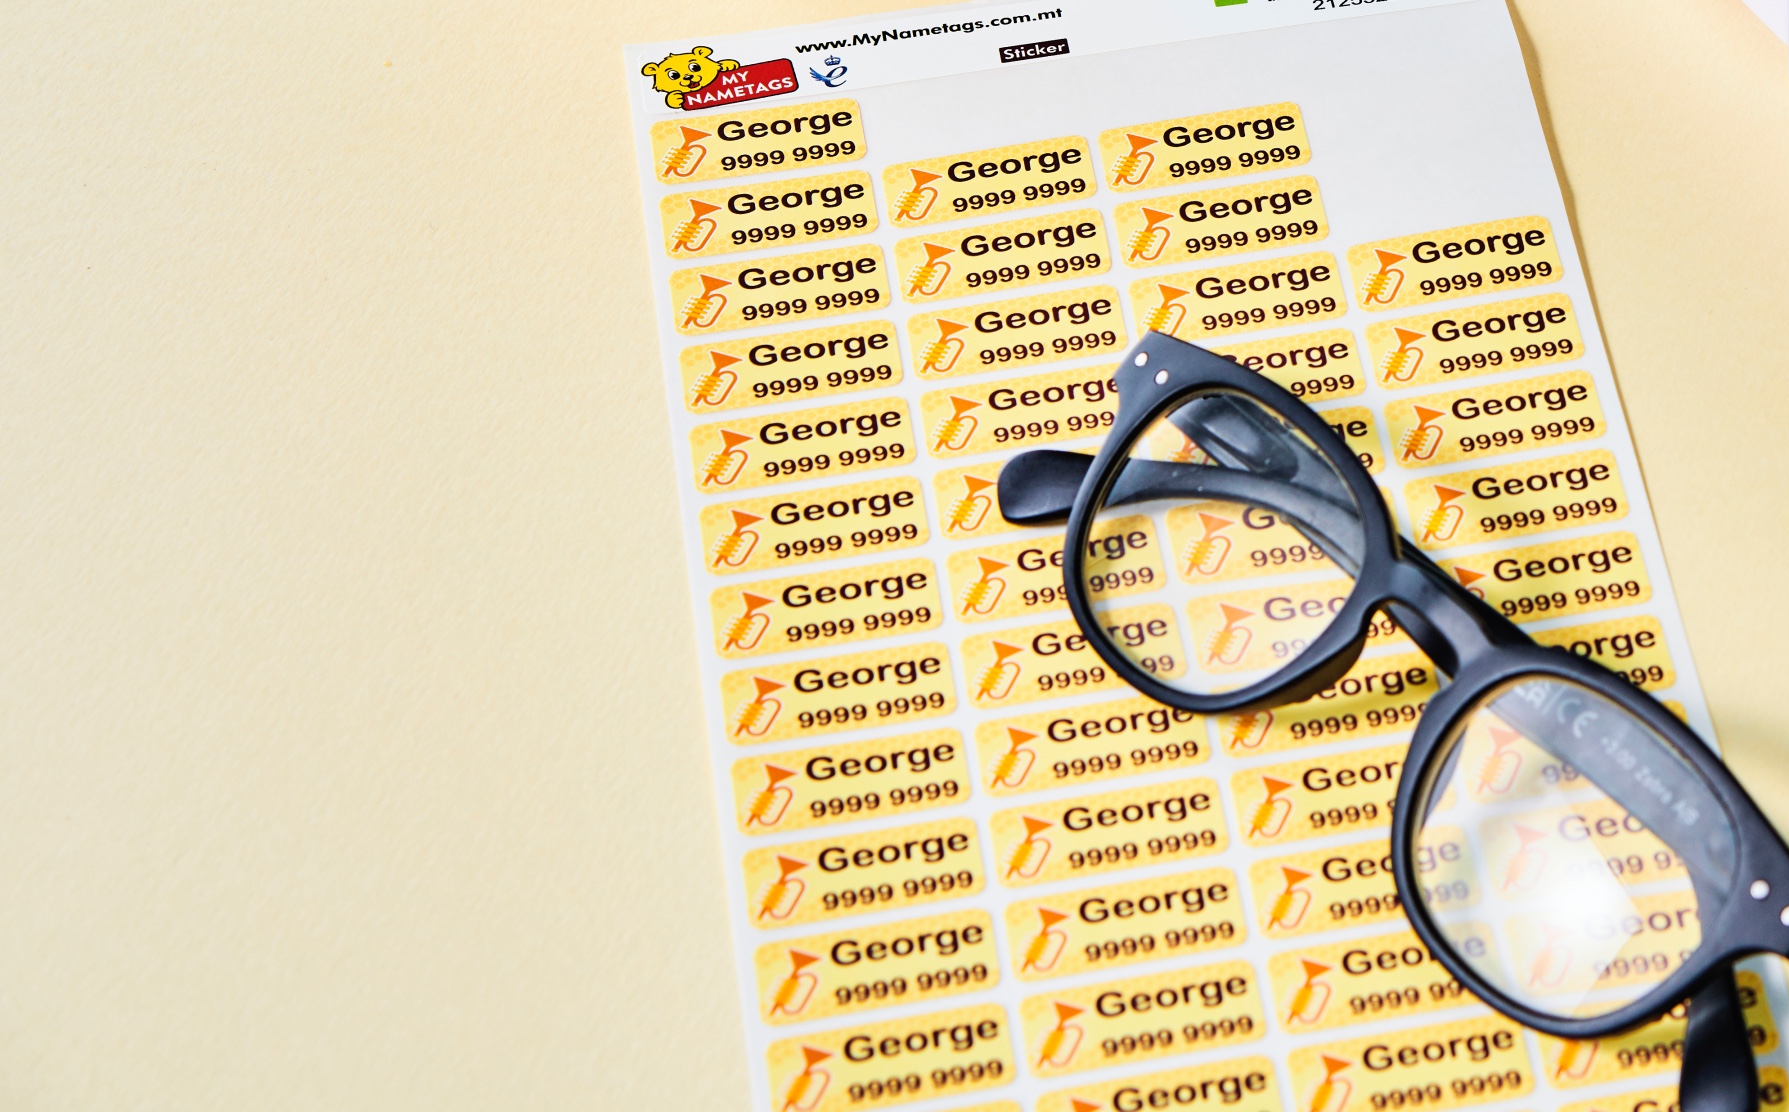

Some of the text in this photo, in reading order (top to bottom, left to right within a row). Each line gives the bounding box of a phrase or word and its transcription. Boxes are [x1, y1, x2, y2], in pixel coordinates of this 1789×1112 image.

[795, 8, 1063, 53] www.MyNametags.com.mt
[1002, 41, 1066, 60] Sticker
[687, 77, 794, 106] NAMETAGS
[722, 71, 749, 86] MY
[717, 112, 852, 141] George
[1163, 116, 1295, 147] George
[721, 141, 855, 171] 9999 9999
[948, 149, 1081, 182] George
[1169, 145, 1300, 178] 9999 9999
[728, 184, 864, 215] George
[953, 178, 1086, 212] 9999 9999
[1179, 189, 1312, 222] George
[732, 214, 867, 245] 9999 9999
[961, 223, 1096, 256] George
[1186, 220, 1318, 253] 9999 9999
[1412, 230, 1545, 263] George
[738, 258, 876, 289] George
[966, 253, 1100, 287] 9999 9999
[1196, 266, 1330, 299] George
[1420, 261, 1552, 295] 9999 9999
[742, 288, 879, 320] 9999 9999
[975, 299, 1111, 333] George
[1202, 297, 1336, 330] 9999 9999
[1432, 308, 1566, 342] George
[749, 334, 888, 366] George
[980, 331, 1116, 364] 9999 9999
[1440, 339, 1573, 373] 9999 9999
[753, 365, 892, 398] 9999 9999
[1452, 385, 1587, 420] George
[760, 411, 901, 445] George
[994, 411, 1115, 442] 9999 999
[1460, 417, 1595, 452] 9999 9999
[764, 443, 905, 477] 9999 9999
[1472, 464, 1609, 500] George
[771, 491, 914, 525] George
[1480, 497, 1617, 533] 9999 9999
[775, 524, 917, 558] 9999 9999
[1017, 531, 1148, 572] Gerge
[1089, 567, 1154, 592] 9999
[1494, 547, 1632, 582] George
[782, 573, 927, 608] George
[1501, 581, 1640, 616] 9999 9999
[787, 607, 931, 642] 9999 9999
[794, 658, 940, 693] George
[1038, 666, 1105, 691] 9999
[798, 693, 944, 728] 9999 9999
[1290, 714, 1358, 739] 9999
[806, 744, 954, 781] George
[1053, 741, 1198, 777] 9999 9999
[1303, 761, 1399, 791] Geor
[810, 781, 958, 817] 9999 9999
[1063, 794, 1210, 831] George
[1310, 803, 1378, 828] 9999
[818, 834, 968, 872] George
[1069, 831, 1216, 866] 9999 9999
[823, 871, 973, 909] 9999 9999
[1079, 884, 1227, 923] George
[831, 926, 983, 965] George
[1096, 978, 1246, 1017] George
[844, 1021, 998, 1062] George
[1362, 1029, 1515, 1071] George
[1112, 1071, 1266, 1112] George
